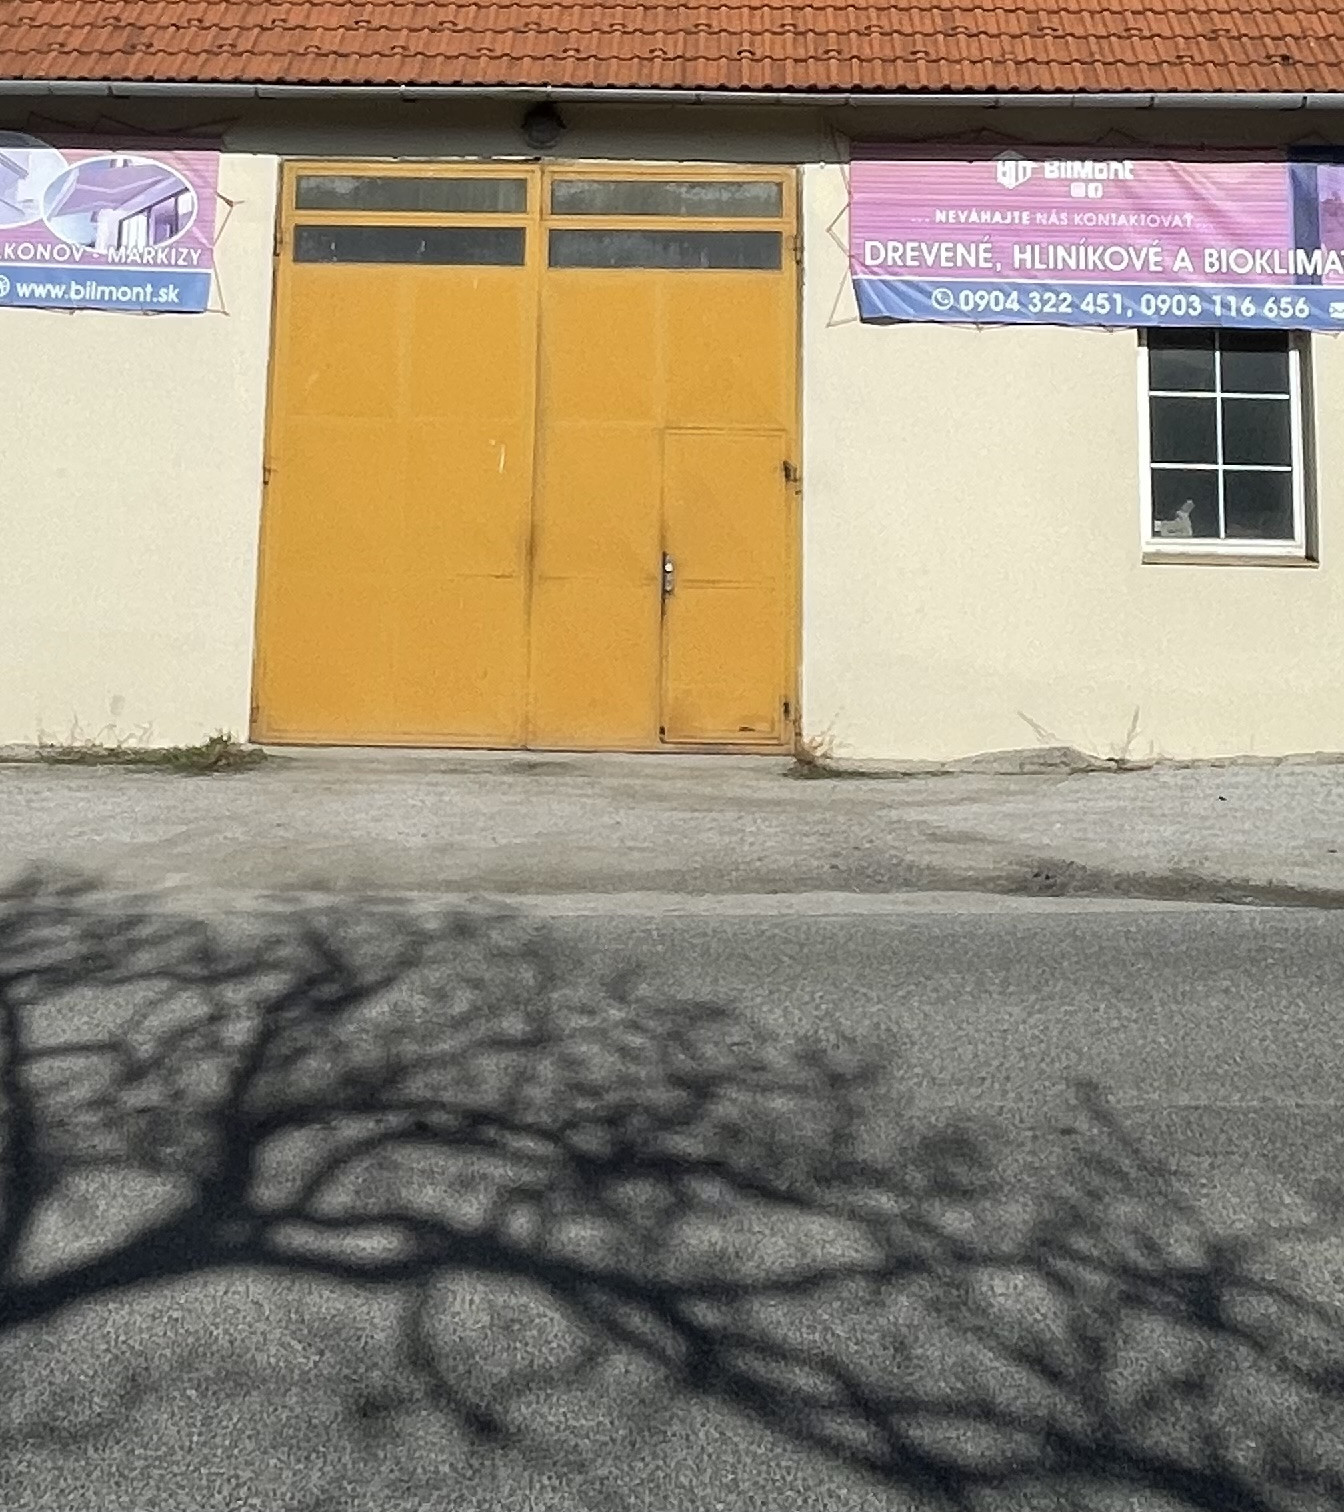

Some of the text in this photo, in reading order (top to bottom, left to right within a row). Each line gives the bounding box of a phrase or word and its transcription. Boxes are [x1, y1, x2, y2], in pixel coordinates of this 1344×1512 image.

[935, 207, 1030, 225] NEVÁHAJTE
[1036, 208, 1068, 226] NÁS
[864, 235, 1002, 272] DREVENÉ,
[1013, 237, 1162, 272] HLINÍKOVÉ
[1172, 247, 1194, 273] A
[16, 280, 180, 303] www.bilmont.sk
[959, 289, 1019, 312] 0904
[1028, 291, 1072, 313] 322
[1081, 292, 1133, 317] 451,
[1141, 293, 1202, 316] 0903
[1212, 294, 1256, 317] 116
[1263, 296, 1310, 318] 656
